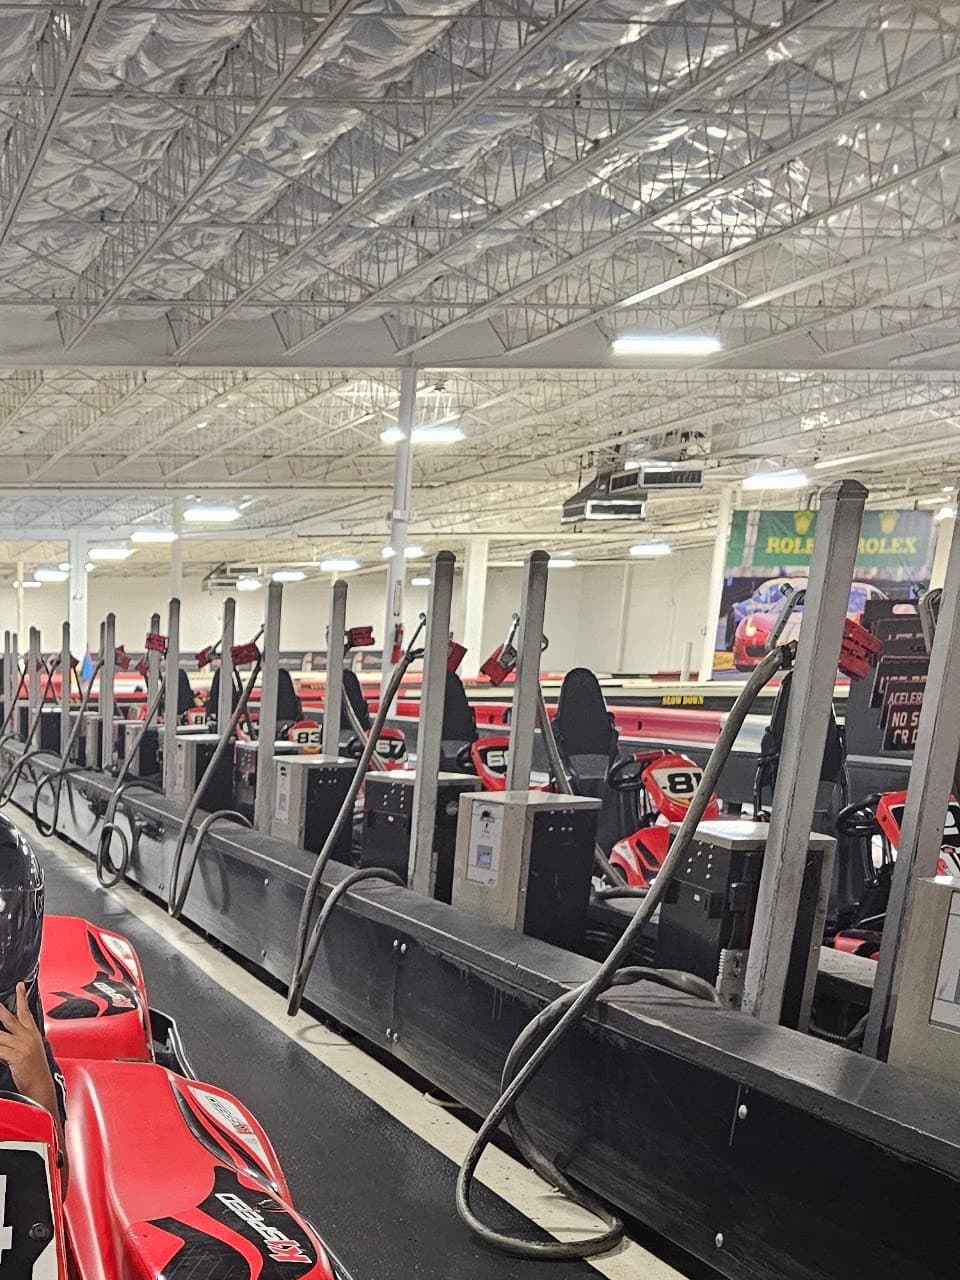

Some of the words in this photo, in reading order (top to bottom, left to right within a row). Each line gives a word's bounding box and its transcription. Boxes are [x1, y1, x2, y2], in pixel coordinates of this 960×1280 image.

[766, 537, 814, 554] ROLE
[891, 711, 908, 727] NO
[297, 731, 322, 744] 83
[486, 750, 508, 767] 6
